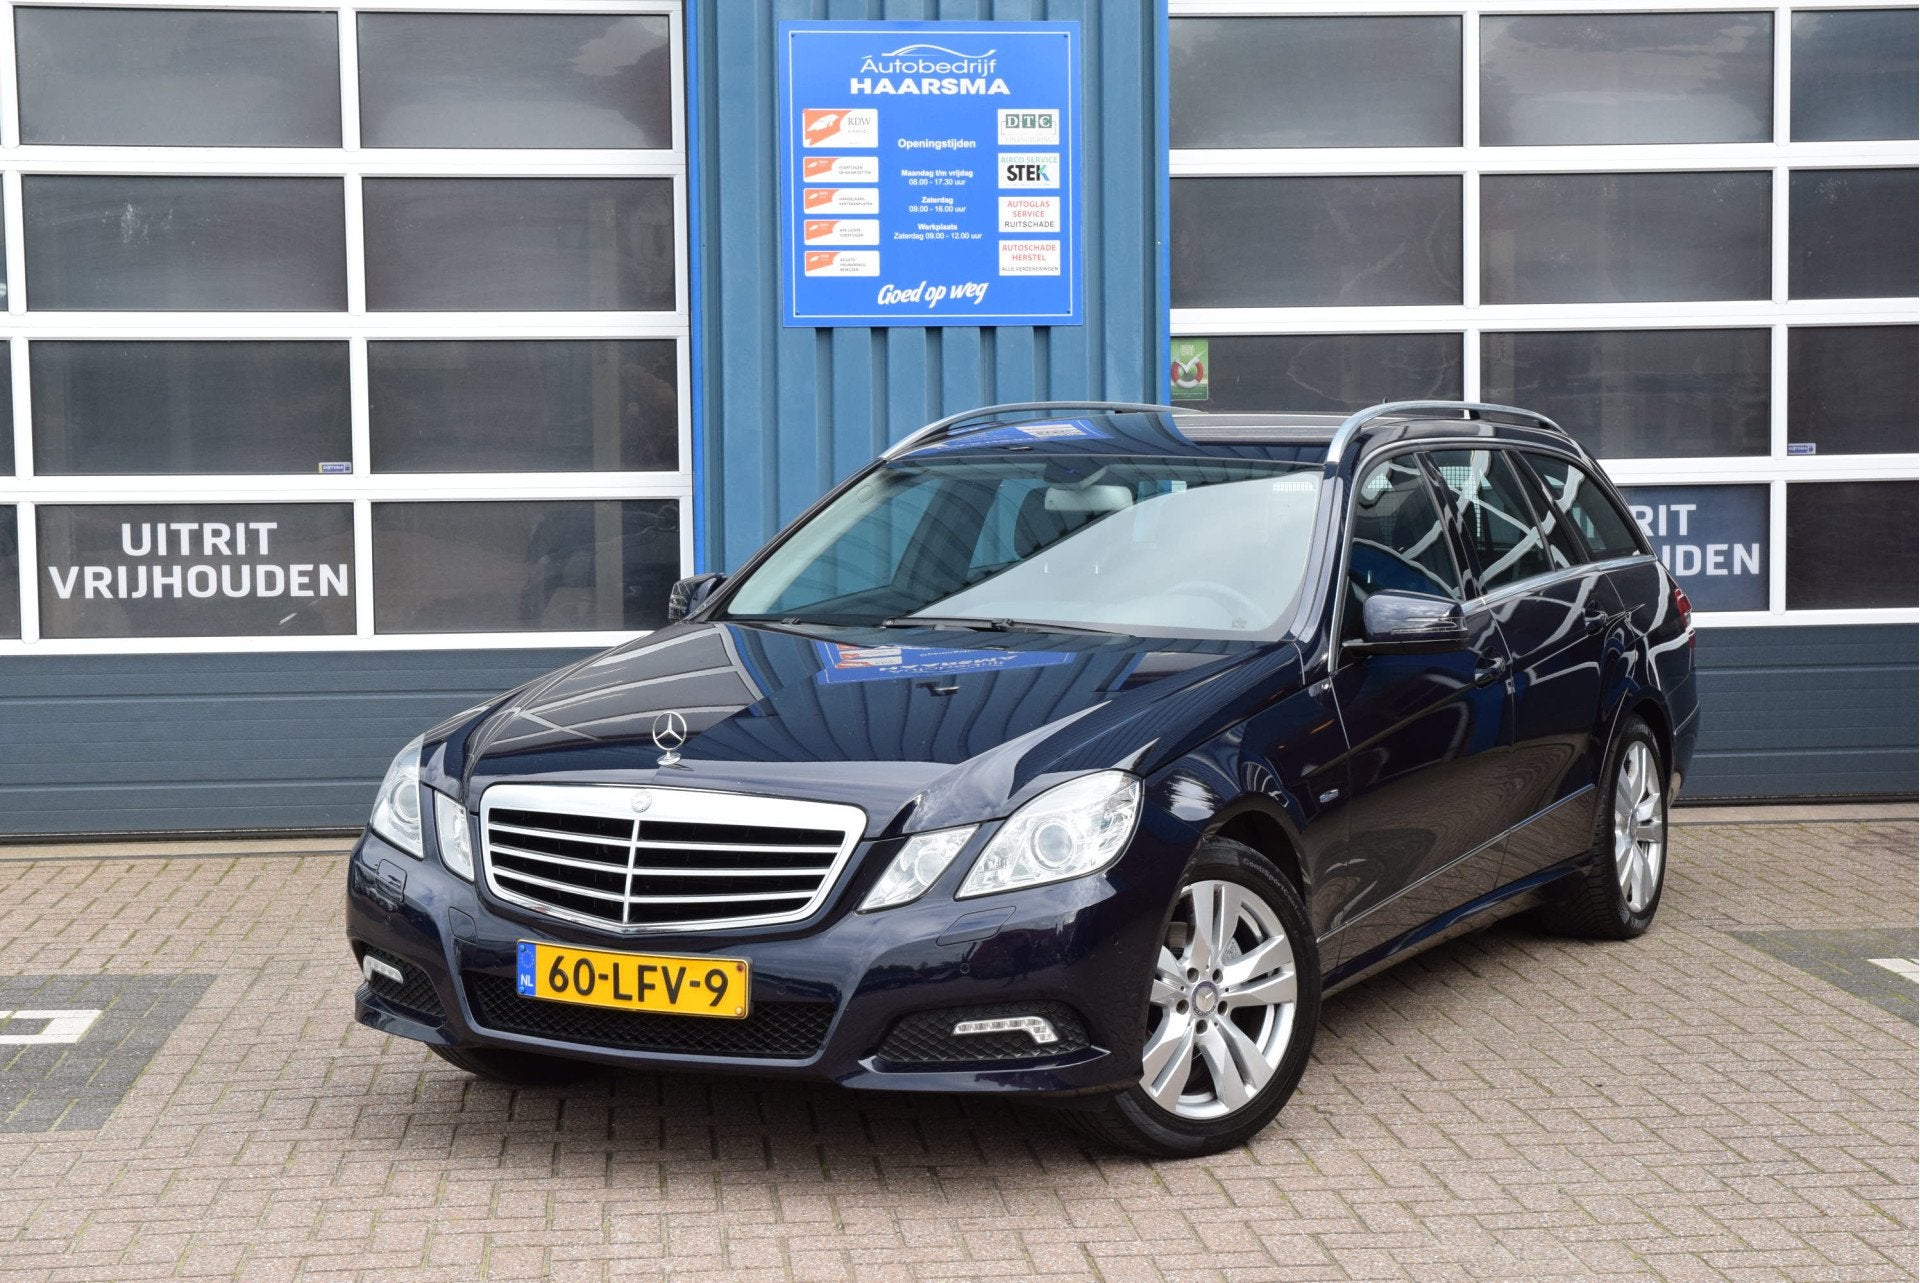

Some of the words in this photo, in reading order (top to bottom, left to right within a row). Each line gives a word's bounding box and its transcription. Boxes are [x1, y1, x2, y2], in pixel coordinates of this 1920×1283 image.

[860, 58, 997, 77] Autobedrijf
[850, 78, 1011, 95] HAARSMA
[848, 117, 871, 126] RDW
[897, 138, 977, 150] Openingstijden
[1000, 156, 1025, 164] AIRCO
[1026, 156, 1058, 164] SERVICE
[901, 169, 934, 178] Maandag
[935, 169, 947, 177] t/m
[948, 169, 974, 178] vrijdag
[1006, 164, 1050, 181] STEK
[921, 196, 954, 205] Zaterdag
[1007, 200, 1050, 208] AUTOGLAS
[1012, 210, 1046, 218] SERVICE
[917, 223, 958, 232] Werkplaats
[1004, 220, 1055, 228] RUITSCHADE
[893, 232, 924, 241] Zaterdag
[1002, 244, 1057, 252] AUTOSCHADE
[877, 280, 927, 305] Goed
[924, 285, 947, 309] op
[949, 281, 990, 305] weg
[1629, 503, 1697, 537] RIT
[121, 522, 278, 557] UITRIT
[48, 563, 349, 599] VRIJHOUDEN
[520, 973, 534, 987] NL
[548, 955, 729, 1007] 60-LFV-9
